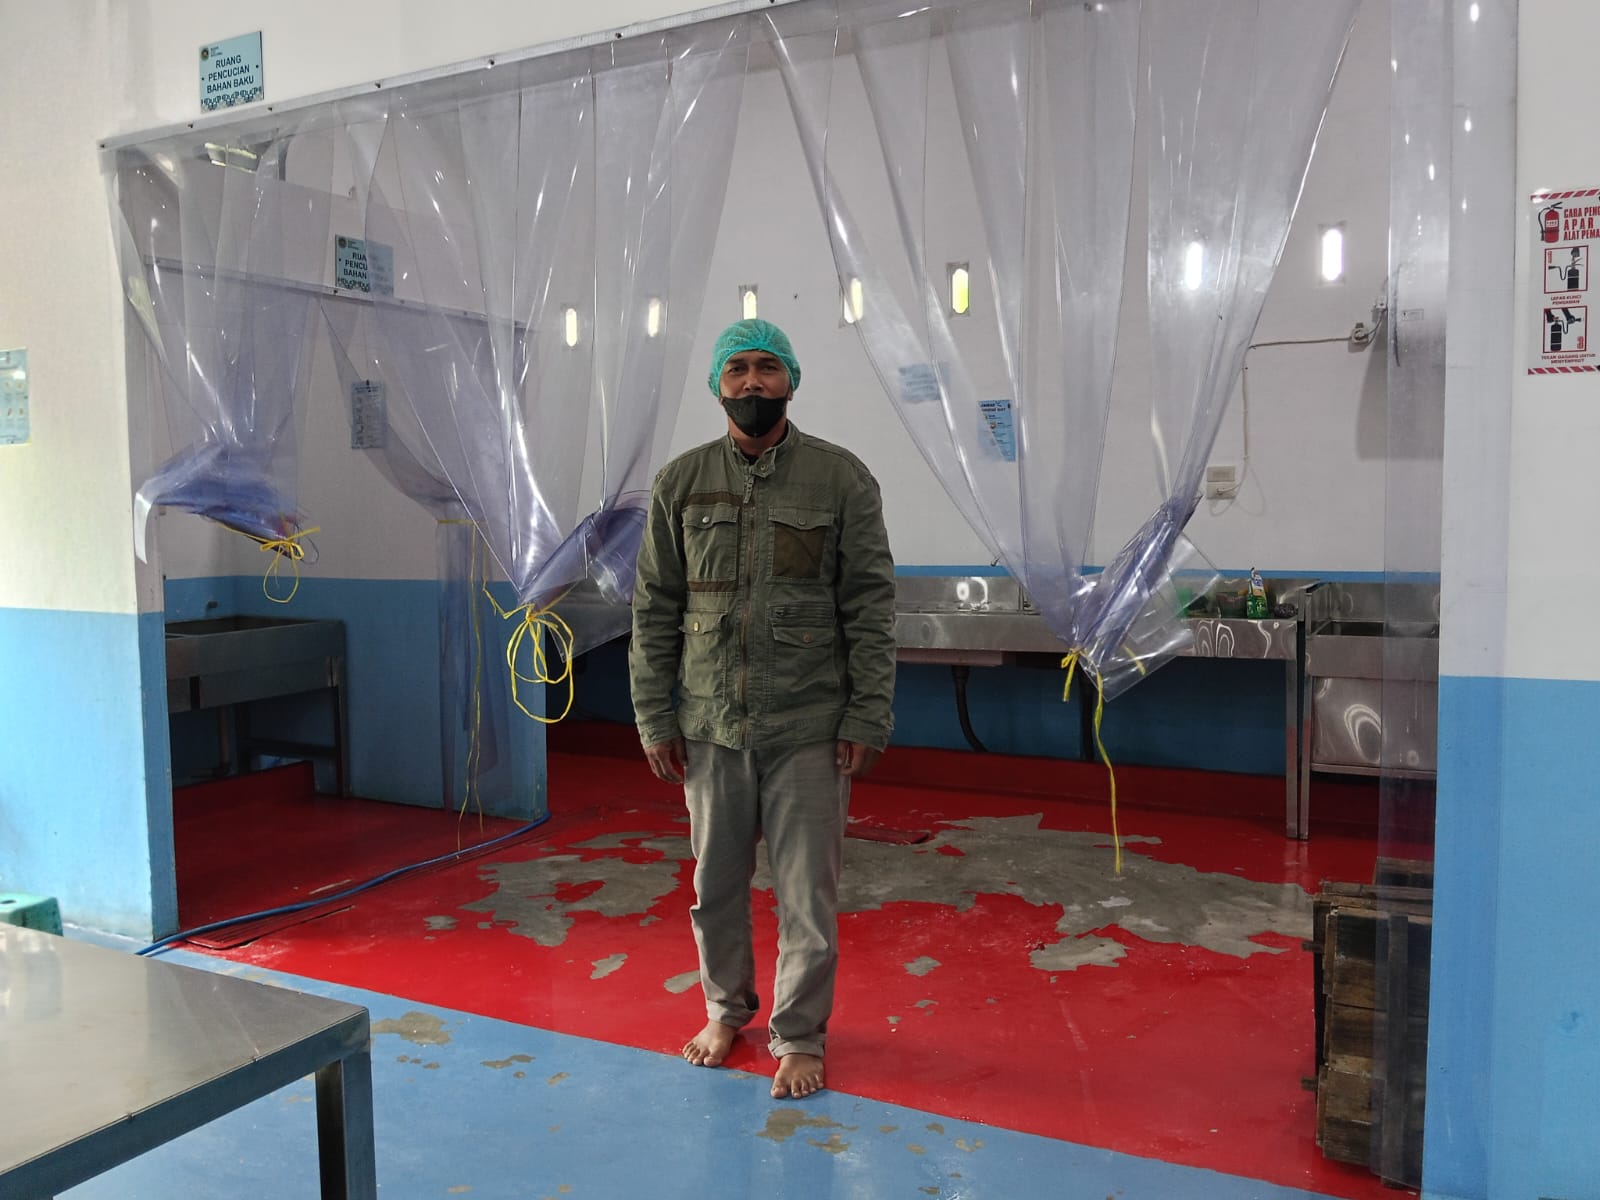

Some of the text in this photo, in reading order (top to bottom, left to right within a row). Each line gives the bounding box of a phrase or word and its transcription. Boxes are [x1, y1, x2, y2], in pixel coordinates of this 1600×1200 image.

[216, 55, 242, 68] RUANG
[208, 64, 250, 82] PENCUCIAN
[206, 75, 254, 94] BAHAN BAKU
[1564, 208, 1582, 218] CARA
[1564, 217, 1594, 230] APAR
[1564, 230, 1580, 240] ALAT
[352, 252, 367, 262] RUA
[344, 268, 367, 280] BAHAN
